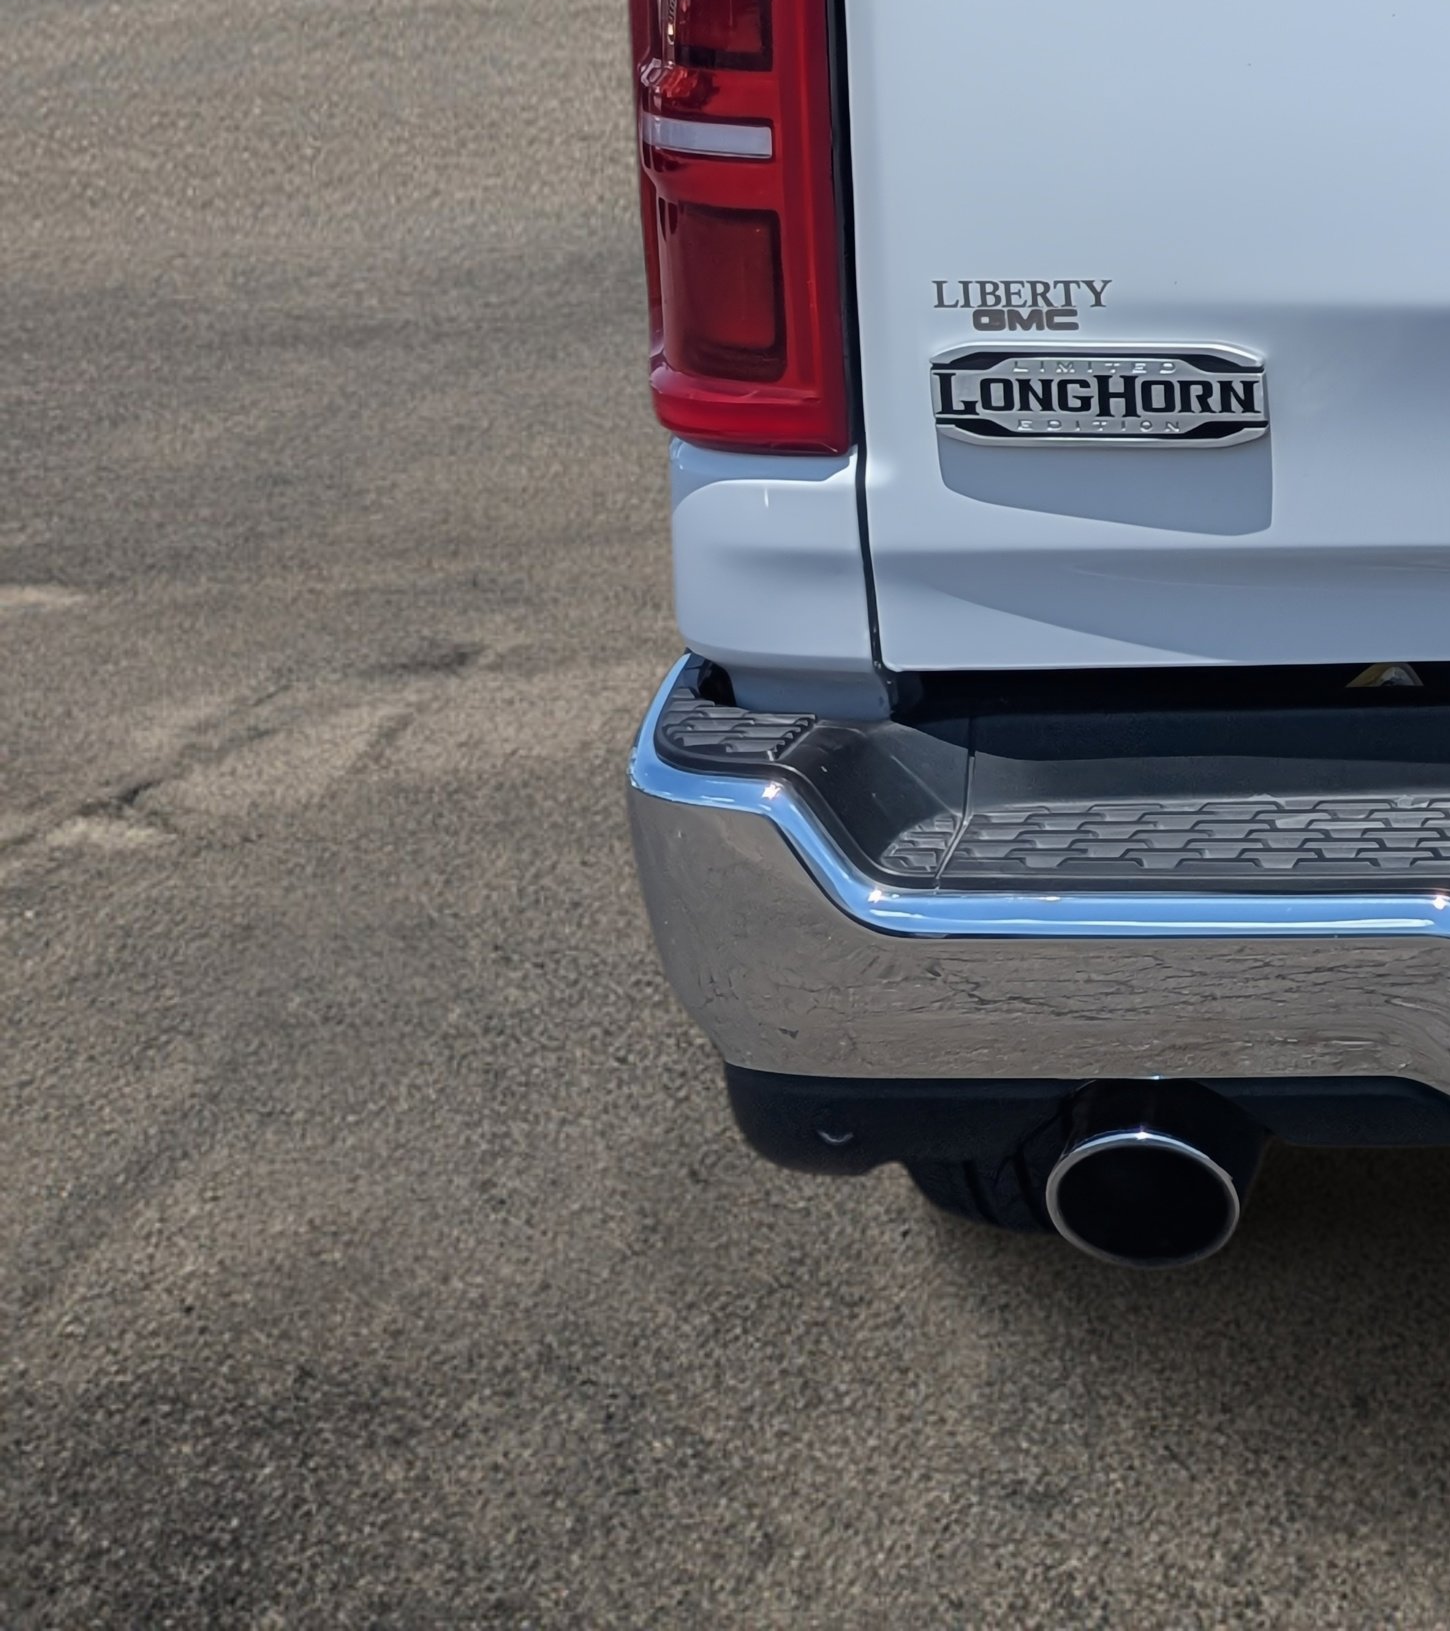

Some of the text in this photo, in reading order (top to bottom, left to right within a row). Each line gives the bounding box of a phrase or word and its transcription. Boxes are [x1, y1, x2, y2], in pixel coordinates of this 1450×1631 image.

[931, 279, 1112, 308] LIBERTY
[972, 308, 1079, 331] GMC
[1012, 361, 1177, 374] LIMITED
[1016, 419, 1181, 432] EDITION
